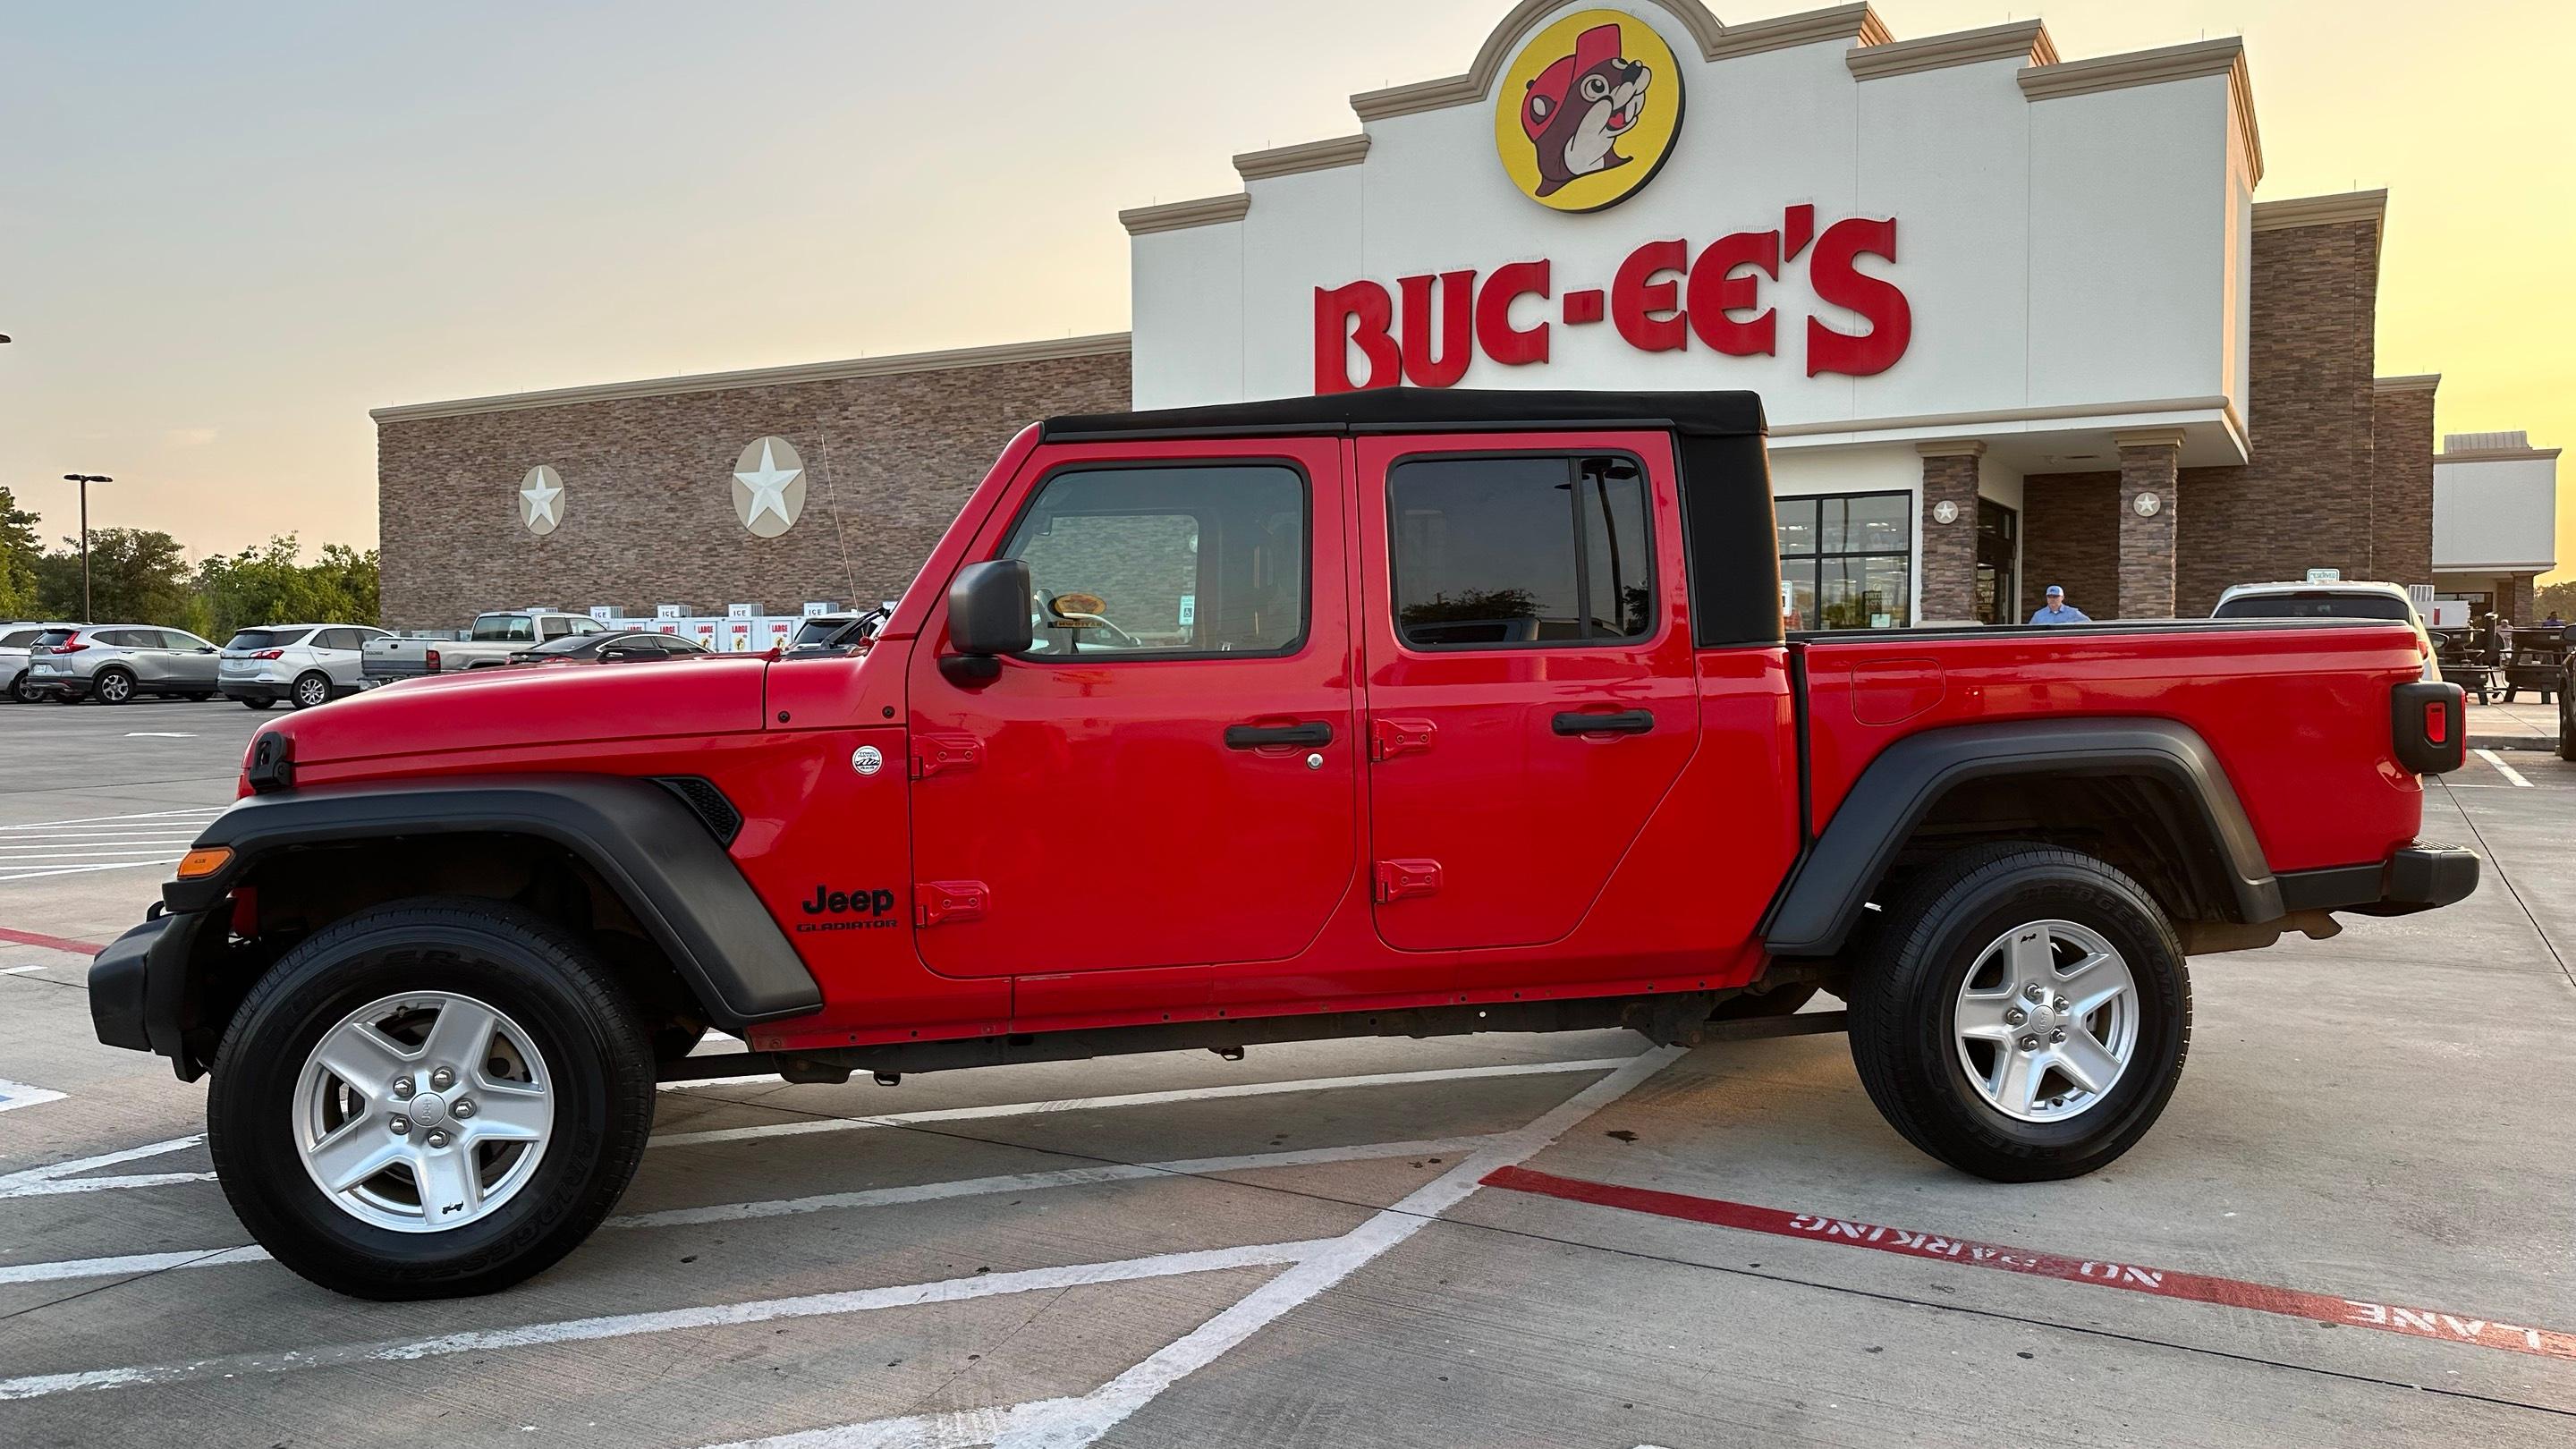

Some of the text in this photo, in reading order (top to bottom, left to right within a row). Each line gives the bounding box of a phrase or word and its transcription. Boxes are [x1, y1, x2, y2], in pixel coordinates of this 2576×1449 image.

[1315, 203, 1911, 394] BUC-EE'S
[659, 625, 675, 633] LARGE
[698, 625, 714, 633] LARGE
[732, 625, 748, 633] LARGE
[772, 624, 788, 632] LARGE
[802, 884, 894, 916] Jeep
[796, 919, 898, 932] GLADIATOR
[2080, 1260, 2163, 1288] NO
[2342, 1300, 2541, 1350] LANE
